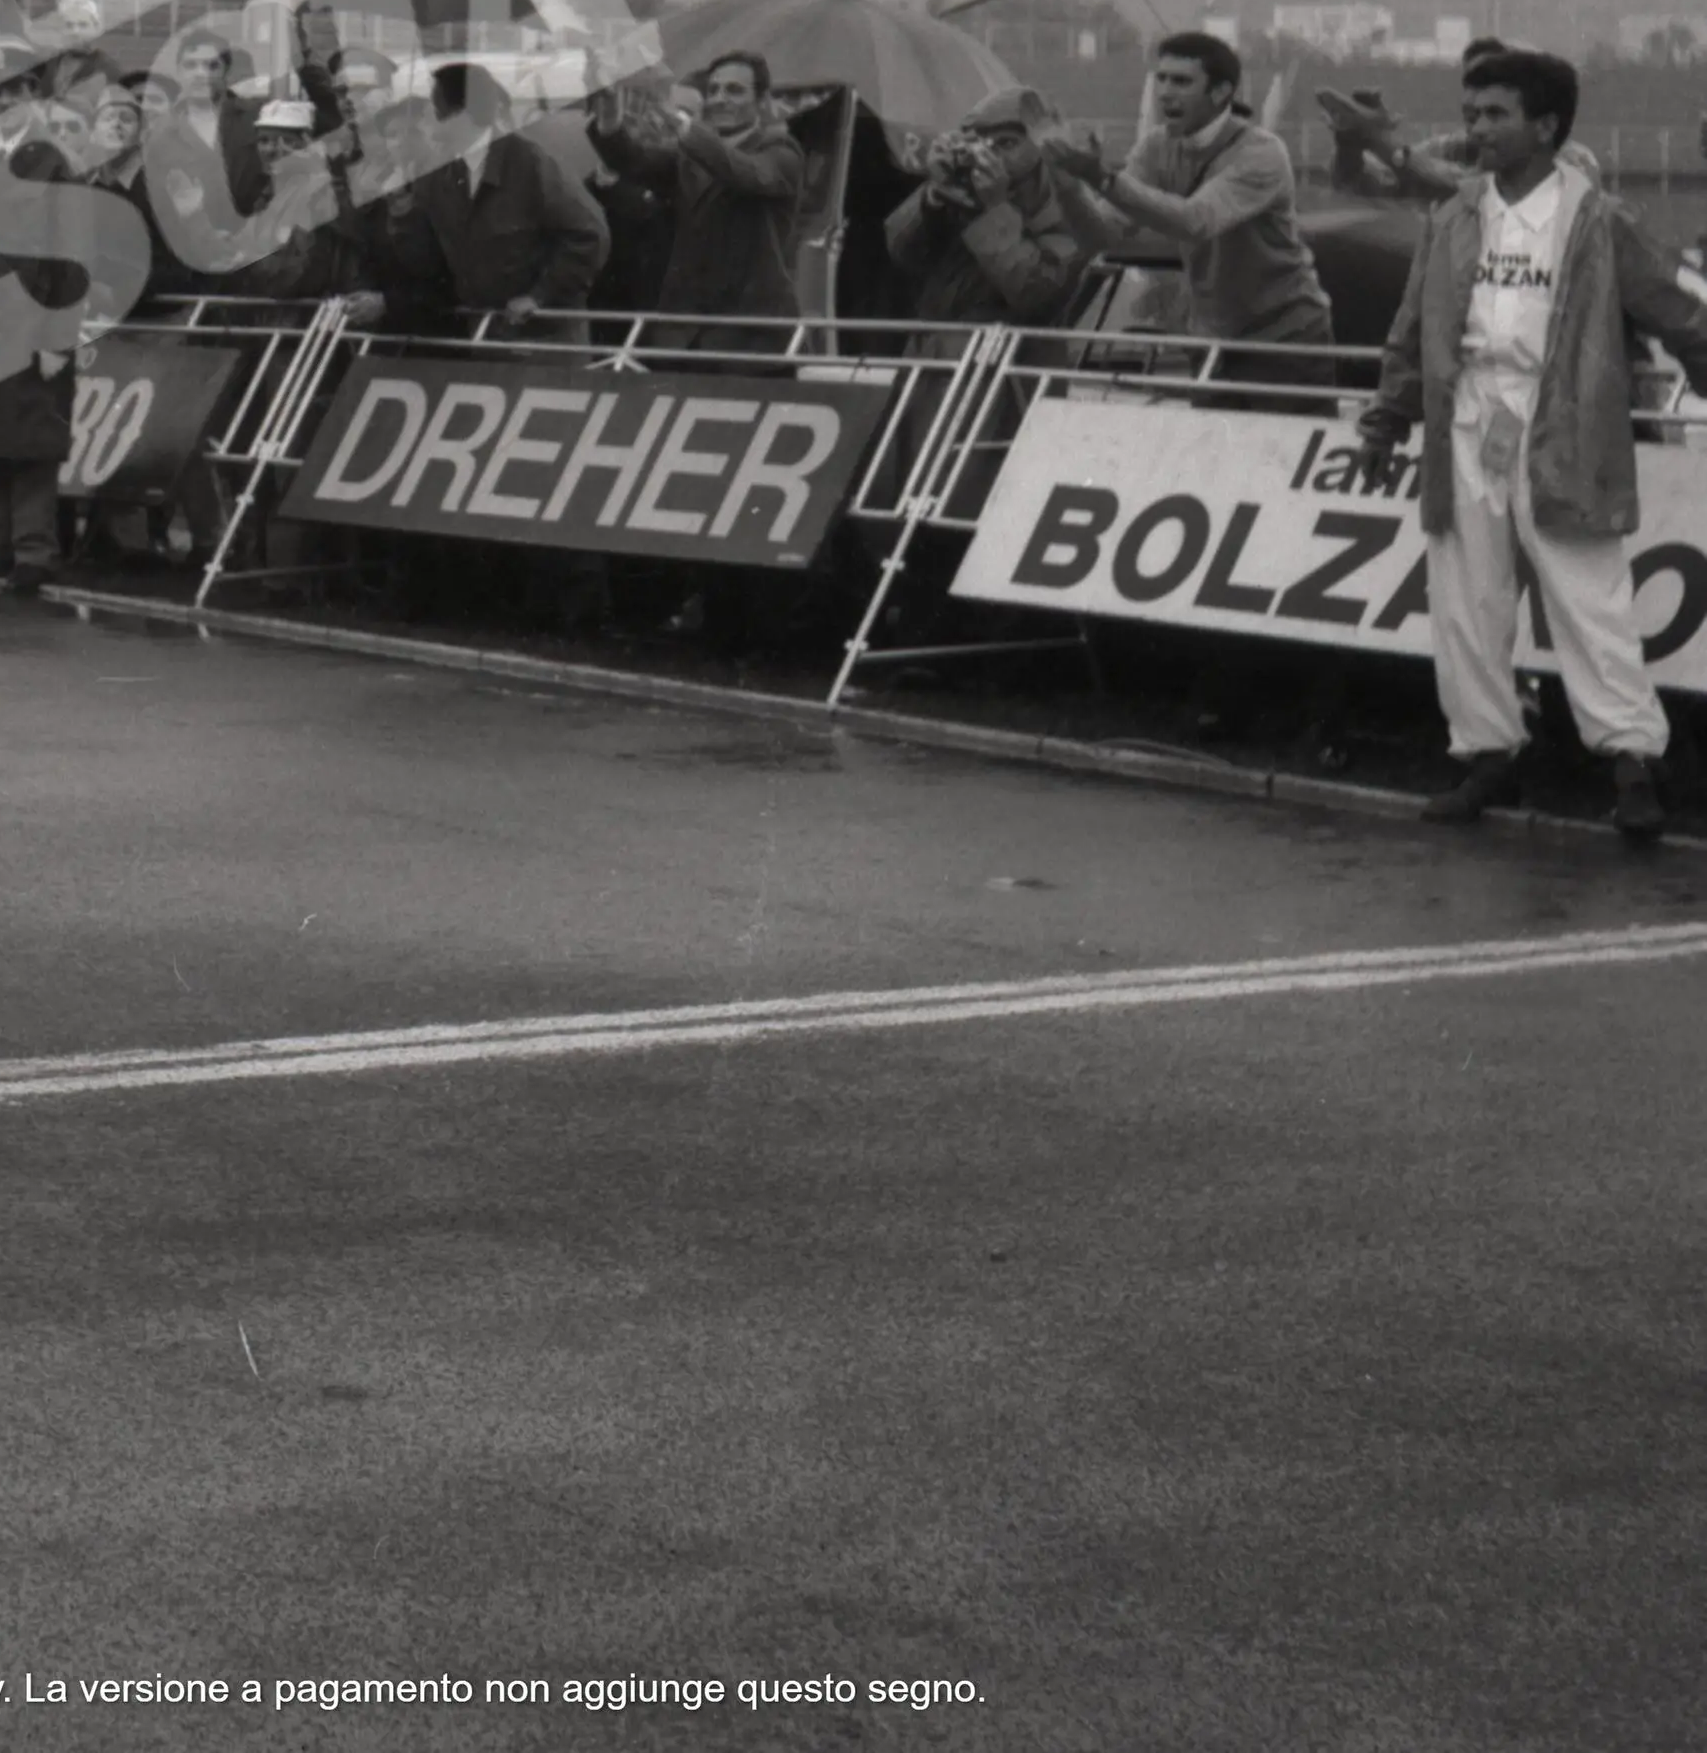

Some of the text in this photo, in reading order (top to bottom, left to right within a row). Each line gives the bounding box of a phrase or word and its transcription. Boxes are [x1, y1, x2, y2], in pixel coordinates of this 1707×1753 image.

[1471, 267, 1553, 289] OLZAN
[313, 377, 841, 544] DREHER
[1289, 426, 1423, 502] lam
